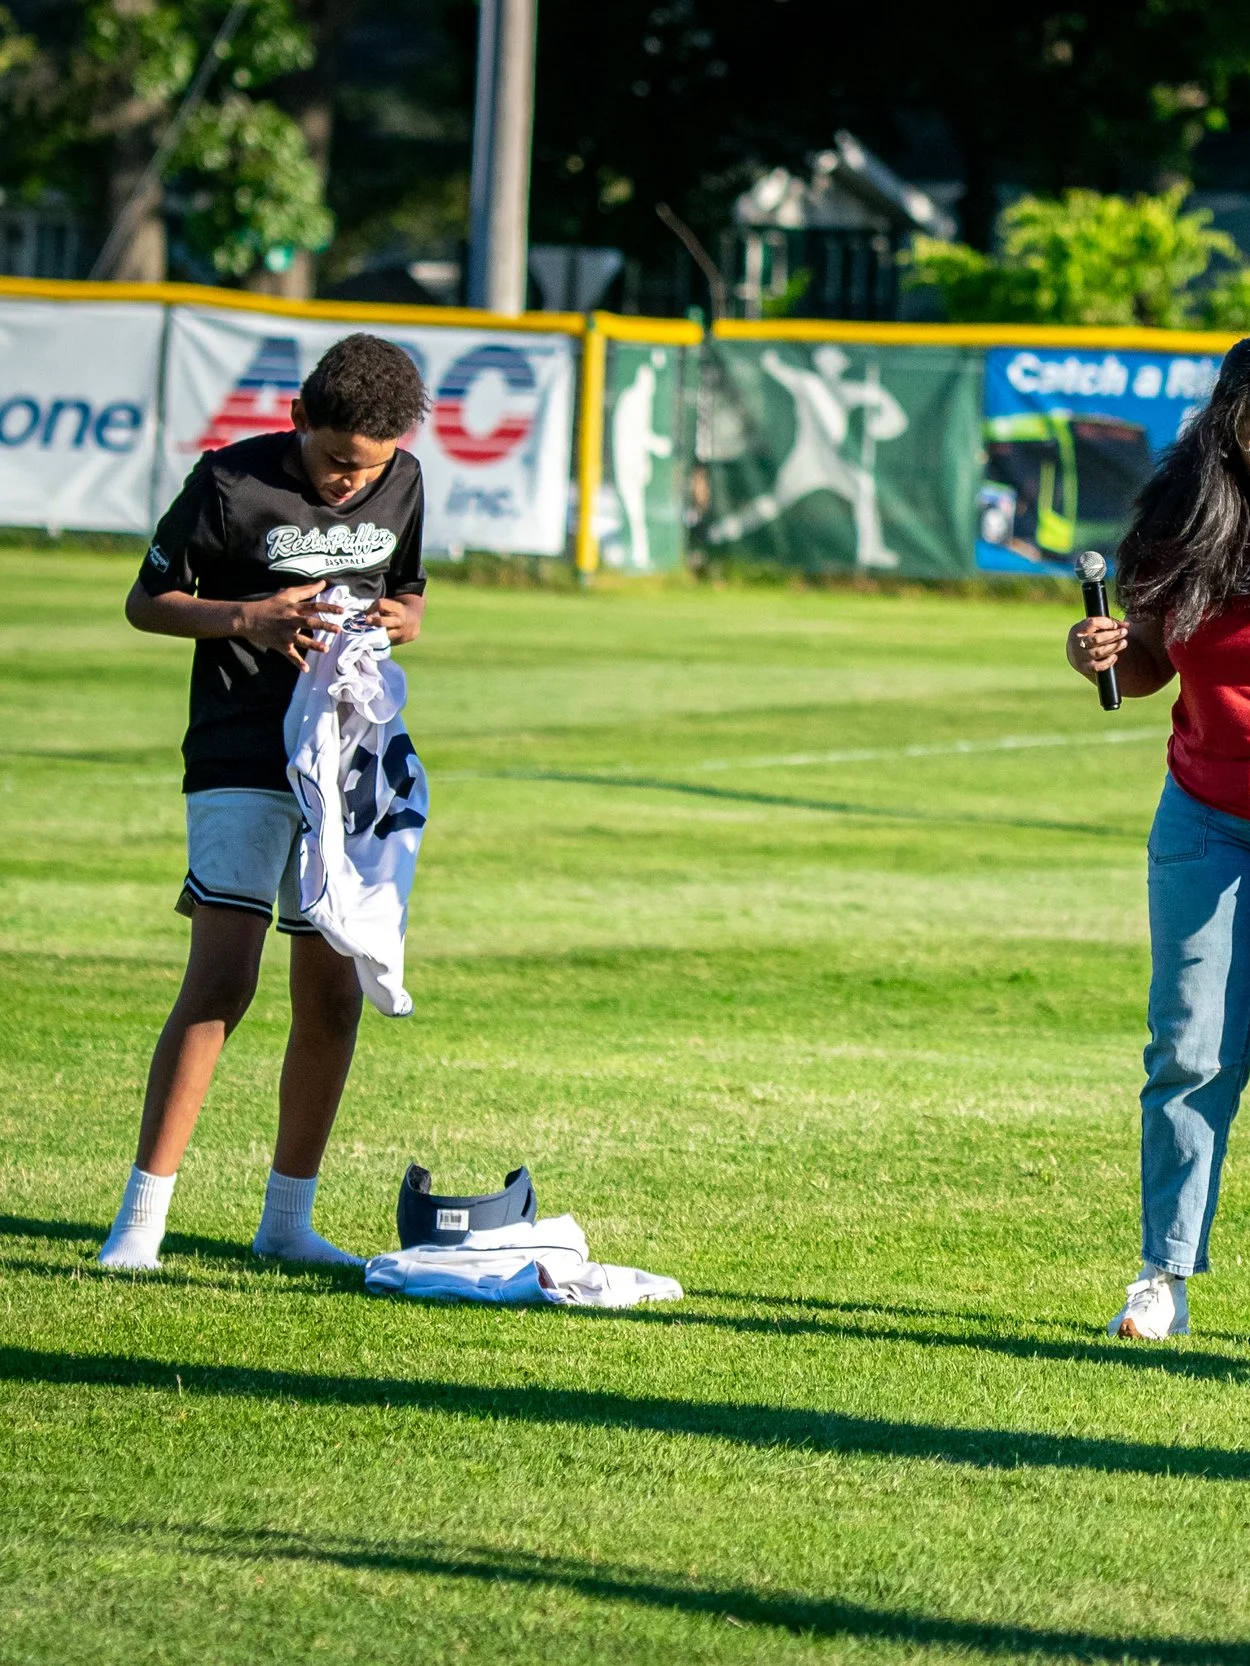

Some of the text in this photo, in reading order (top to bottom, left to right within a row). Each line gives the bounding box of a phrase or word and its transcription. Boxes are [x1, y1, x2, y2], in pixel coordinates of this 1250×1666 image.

[1006, 352, 1129, 396] Catch
[1133, 365, 1163, 398] a
[0, 395, 142, 453] one
